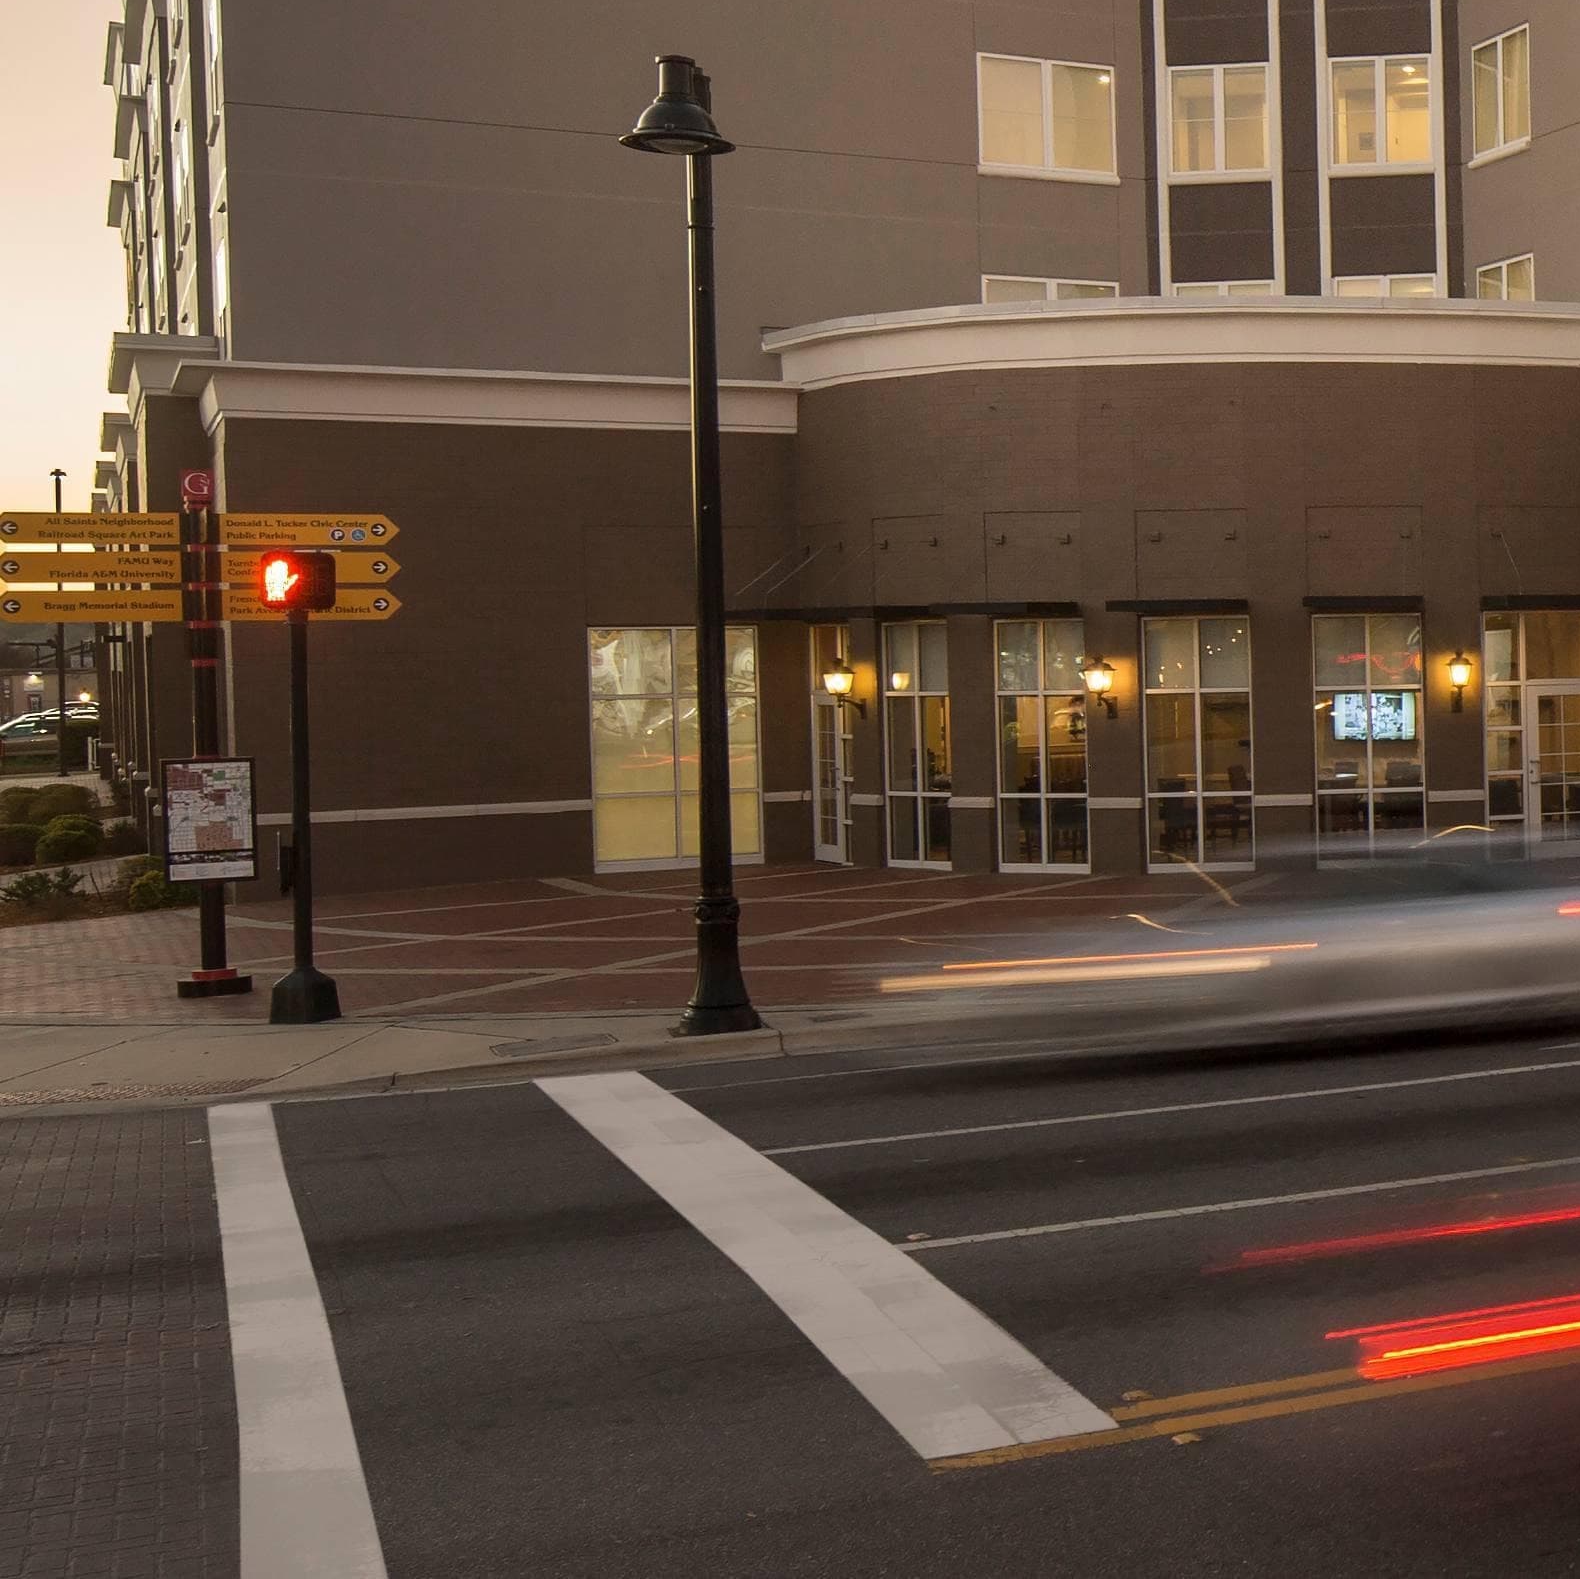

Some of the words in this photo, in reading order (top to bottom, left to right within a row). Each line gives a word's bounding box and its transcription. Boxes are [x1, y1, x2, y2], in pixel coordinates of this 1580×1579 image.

[46, 517, 60, 526] All
[63, 517, 97, 526] Saints
[100, 517, 174, 527] Neighborhood
[38, 530, 84, 538] Railroad
[87, 530, 126, 540] Square
[129, 530, 147, 538] Art
[149, 530, 174, 538] Park
[226, 531, 257, 540] Public
[258, 531, 297, 541] Parking
[117, 557, 149, 565] FAMU
[151, 557, 174, 566] Way
[48, 570, 89, 578] Florida
[93, 570, 118, 578] A&M
[120, 570, 175, 579] University
[44, 602, 76, 611] Bragg
[79, 602, 128, 610] Memorial
[130, 602, 175, 610] Stadium
[230, 606, 253, 614] Park
[334, 605, 372, 614] District
